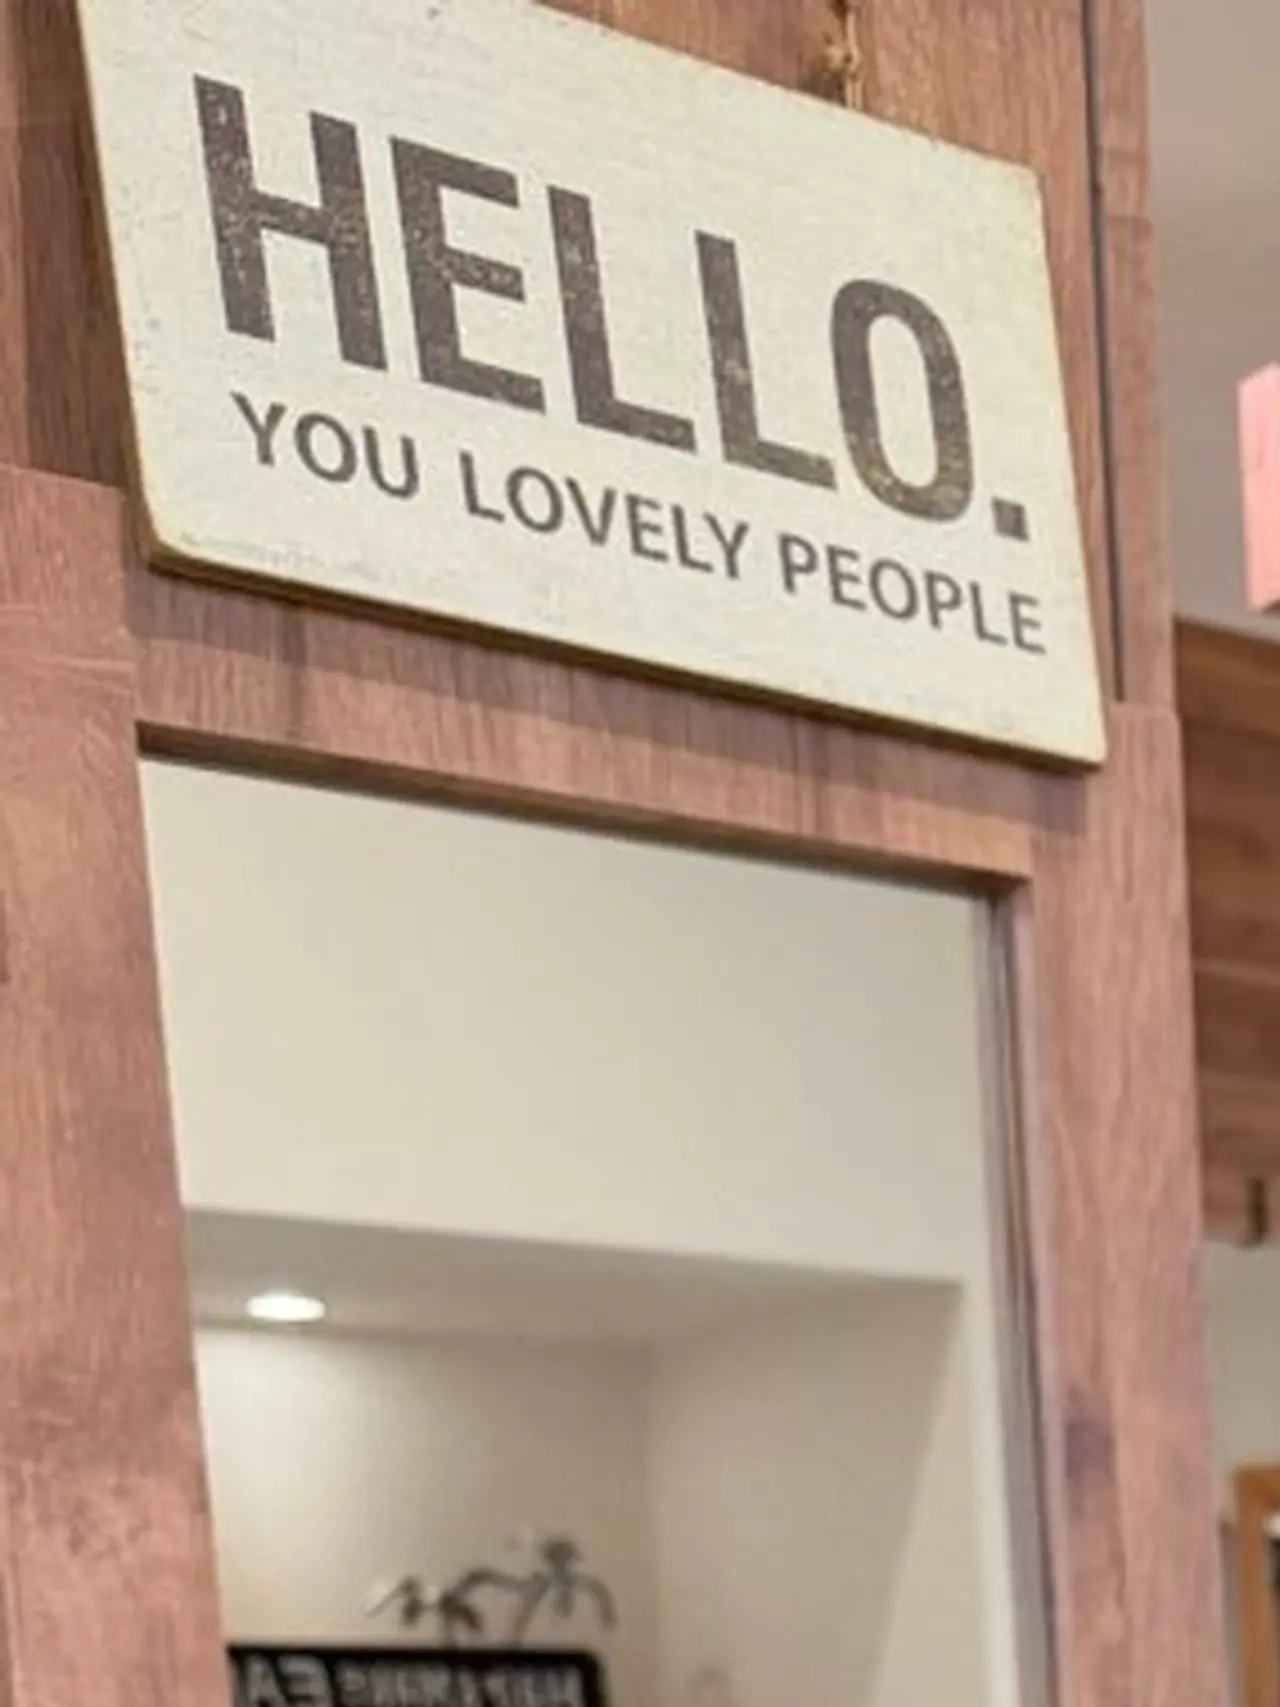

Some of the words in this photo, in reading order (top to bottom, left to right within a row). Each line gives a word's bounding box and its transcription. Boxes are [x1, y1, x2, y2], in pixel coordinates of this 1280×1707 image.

[193, 74, 1030, 542] HELLO.
[231, 392, 420, 500] YOU
[459, 450, 749, 579] LOVELY
[778, 533, 1045, 654] PEOPLE
